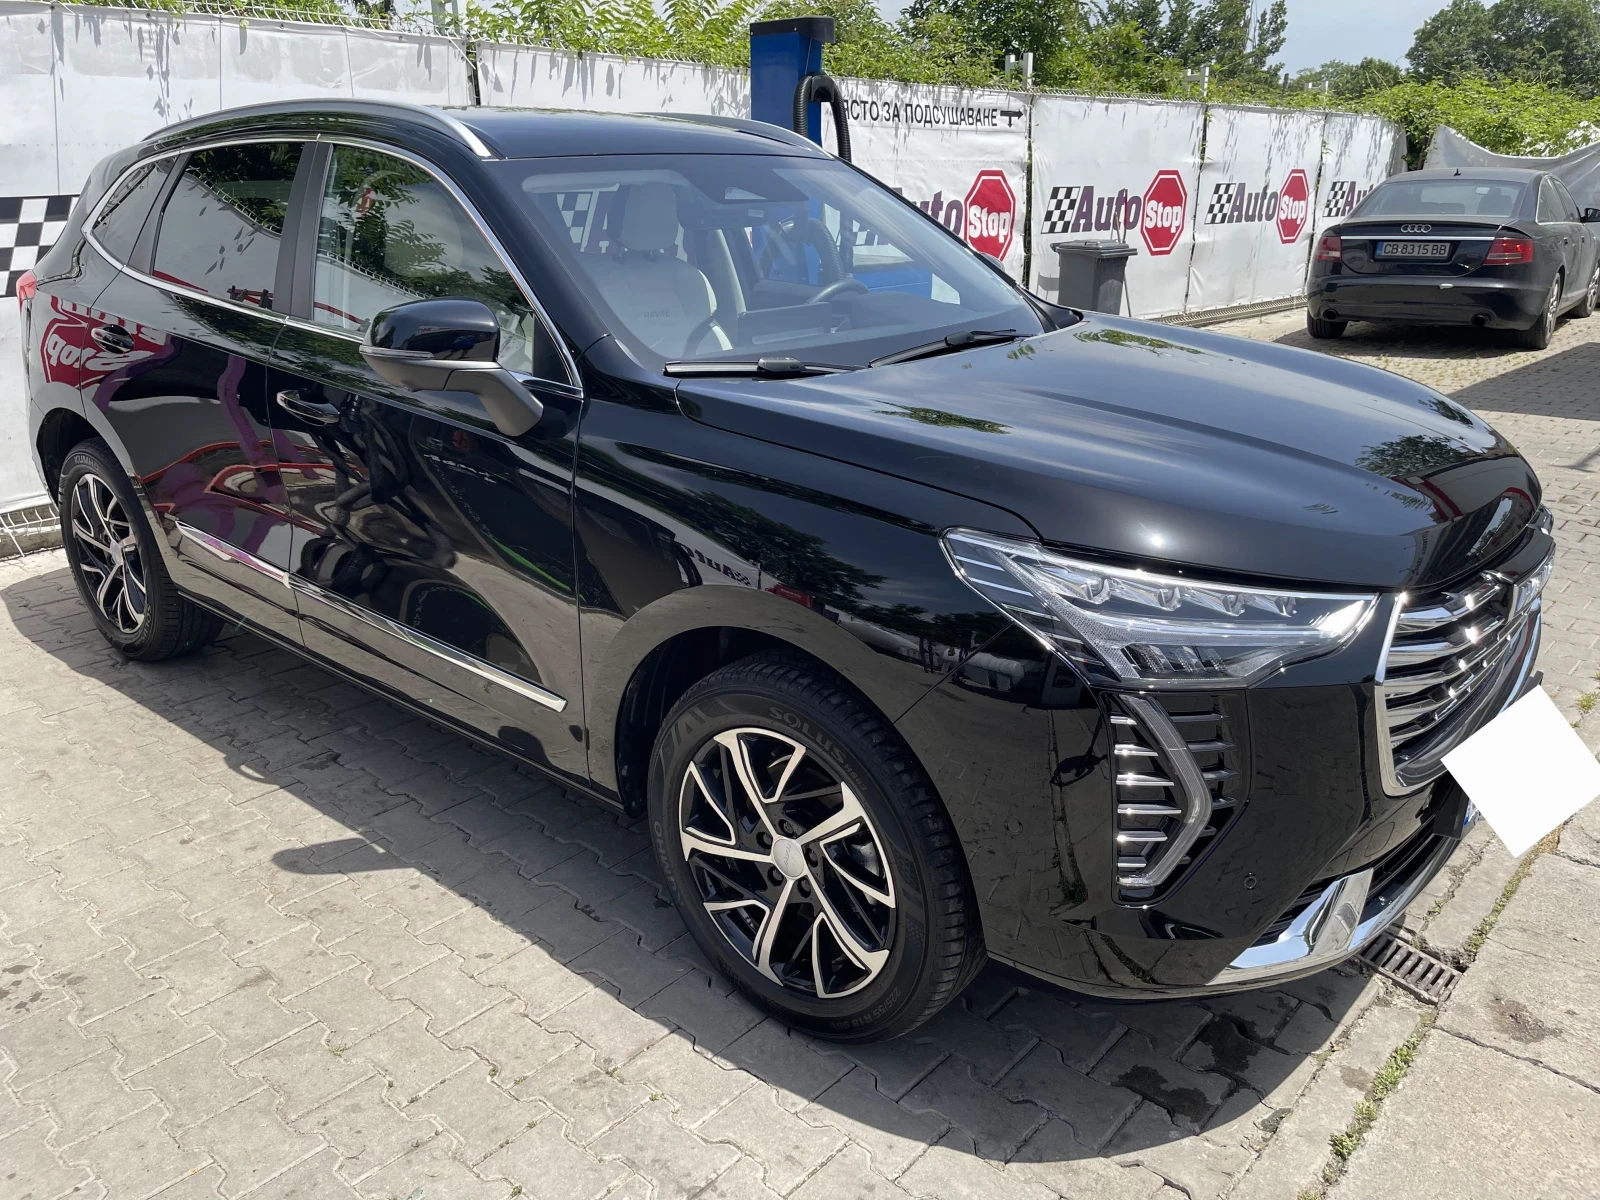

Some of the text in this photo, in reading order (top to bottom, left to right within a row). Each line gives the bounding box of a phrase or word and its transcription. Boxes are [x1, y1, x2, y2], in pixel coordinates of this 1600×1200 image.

[843, 100, 998, 128] ЯСТО ЗА ПОДСУШАВАНЕ
[1071, 186, 1183, 233] Auto Stop
[1227, 183, 1306, 225] Auto Stop
[969, 205, 1011, 243] Stop
[1383, 243, 1447, 256] CB 8315 BB
[643, 310, 671, 319] HAVAL
[73, 455, 100, 470] KUMHO
[768, 706, 848, 764] SOLUS
[873, 985, 902, 1018] 225/55
[851, 1010, 874, 1028] R18
